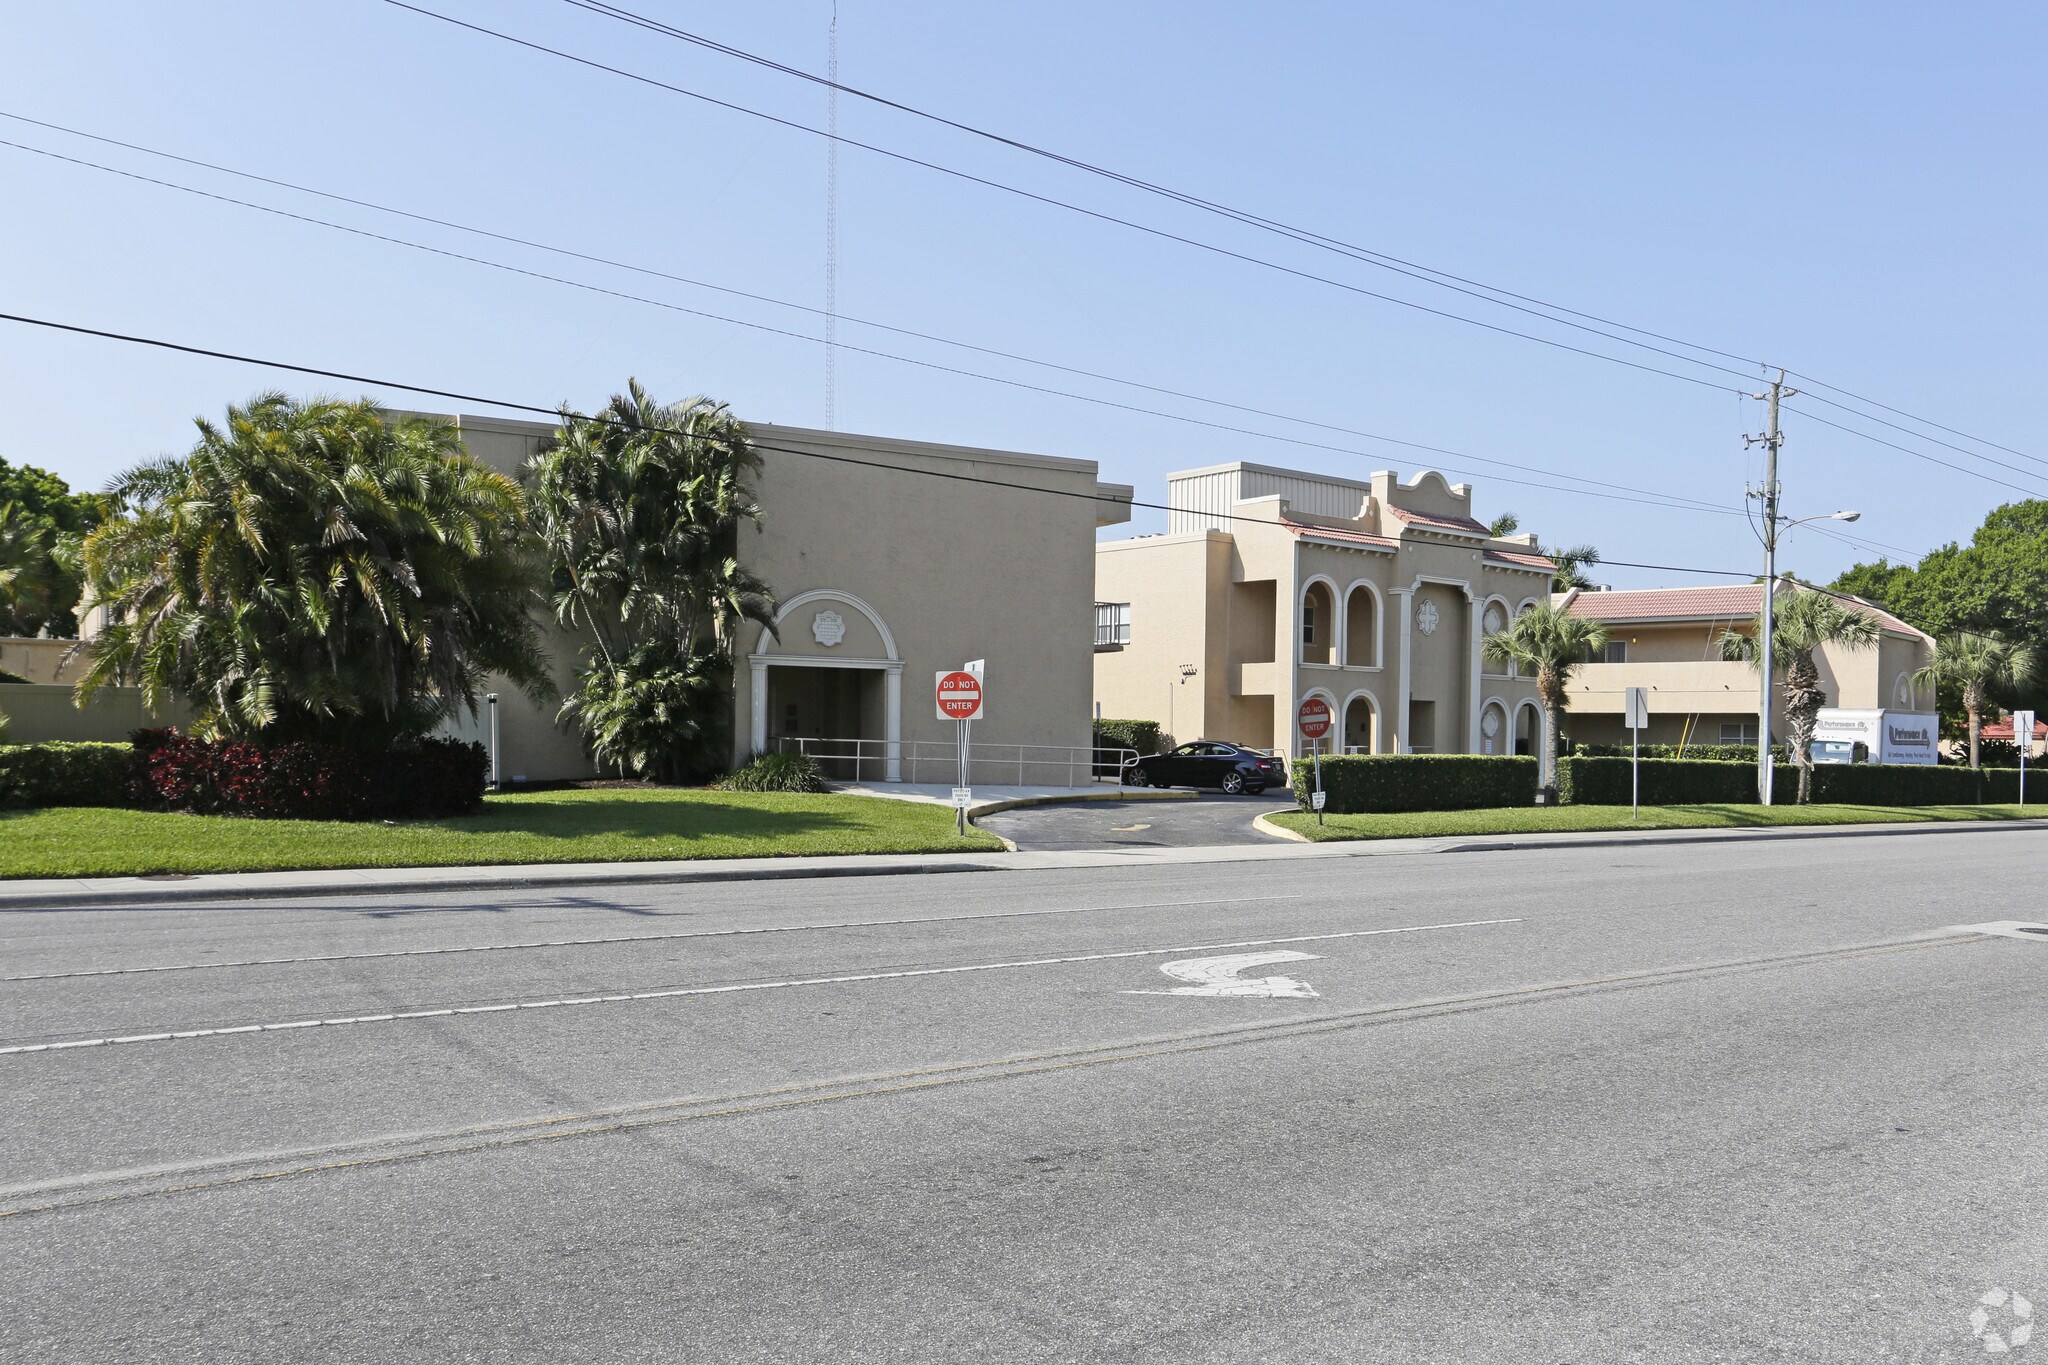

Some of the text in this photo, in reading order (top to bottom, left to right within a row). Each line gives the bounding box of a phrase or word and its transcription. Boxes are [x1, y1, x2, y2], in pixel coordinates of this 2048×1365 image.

[943, 681, 955, 689] DO
[946, 702, 973, 710] ENTER
[1895, 728, 1920, 739] Performance
